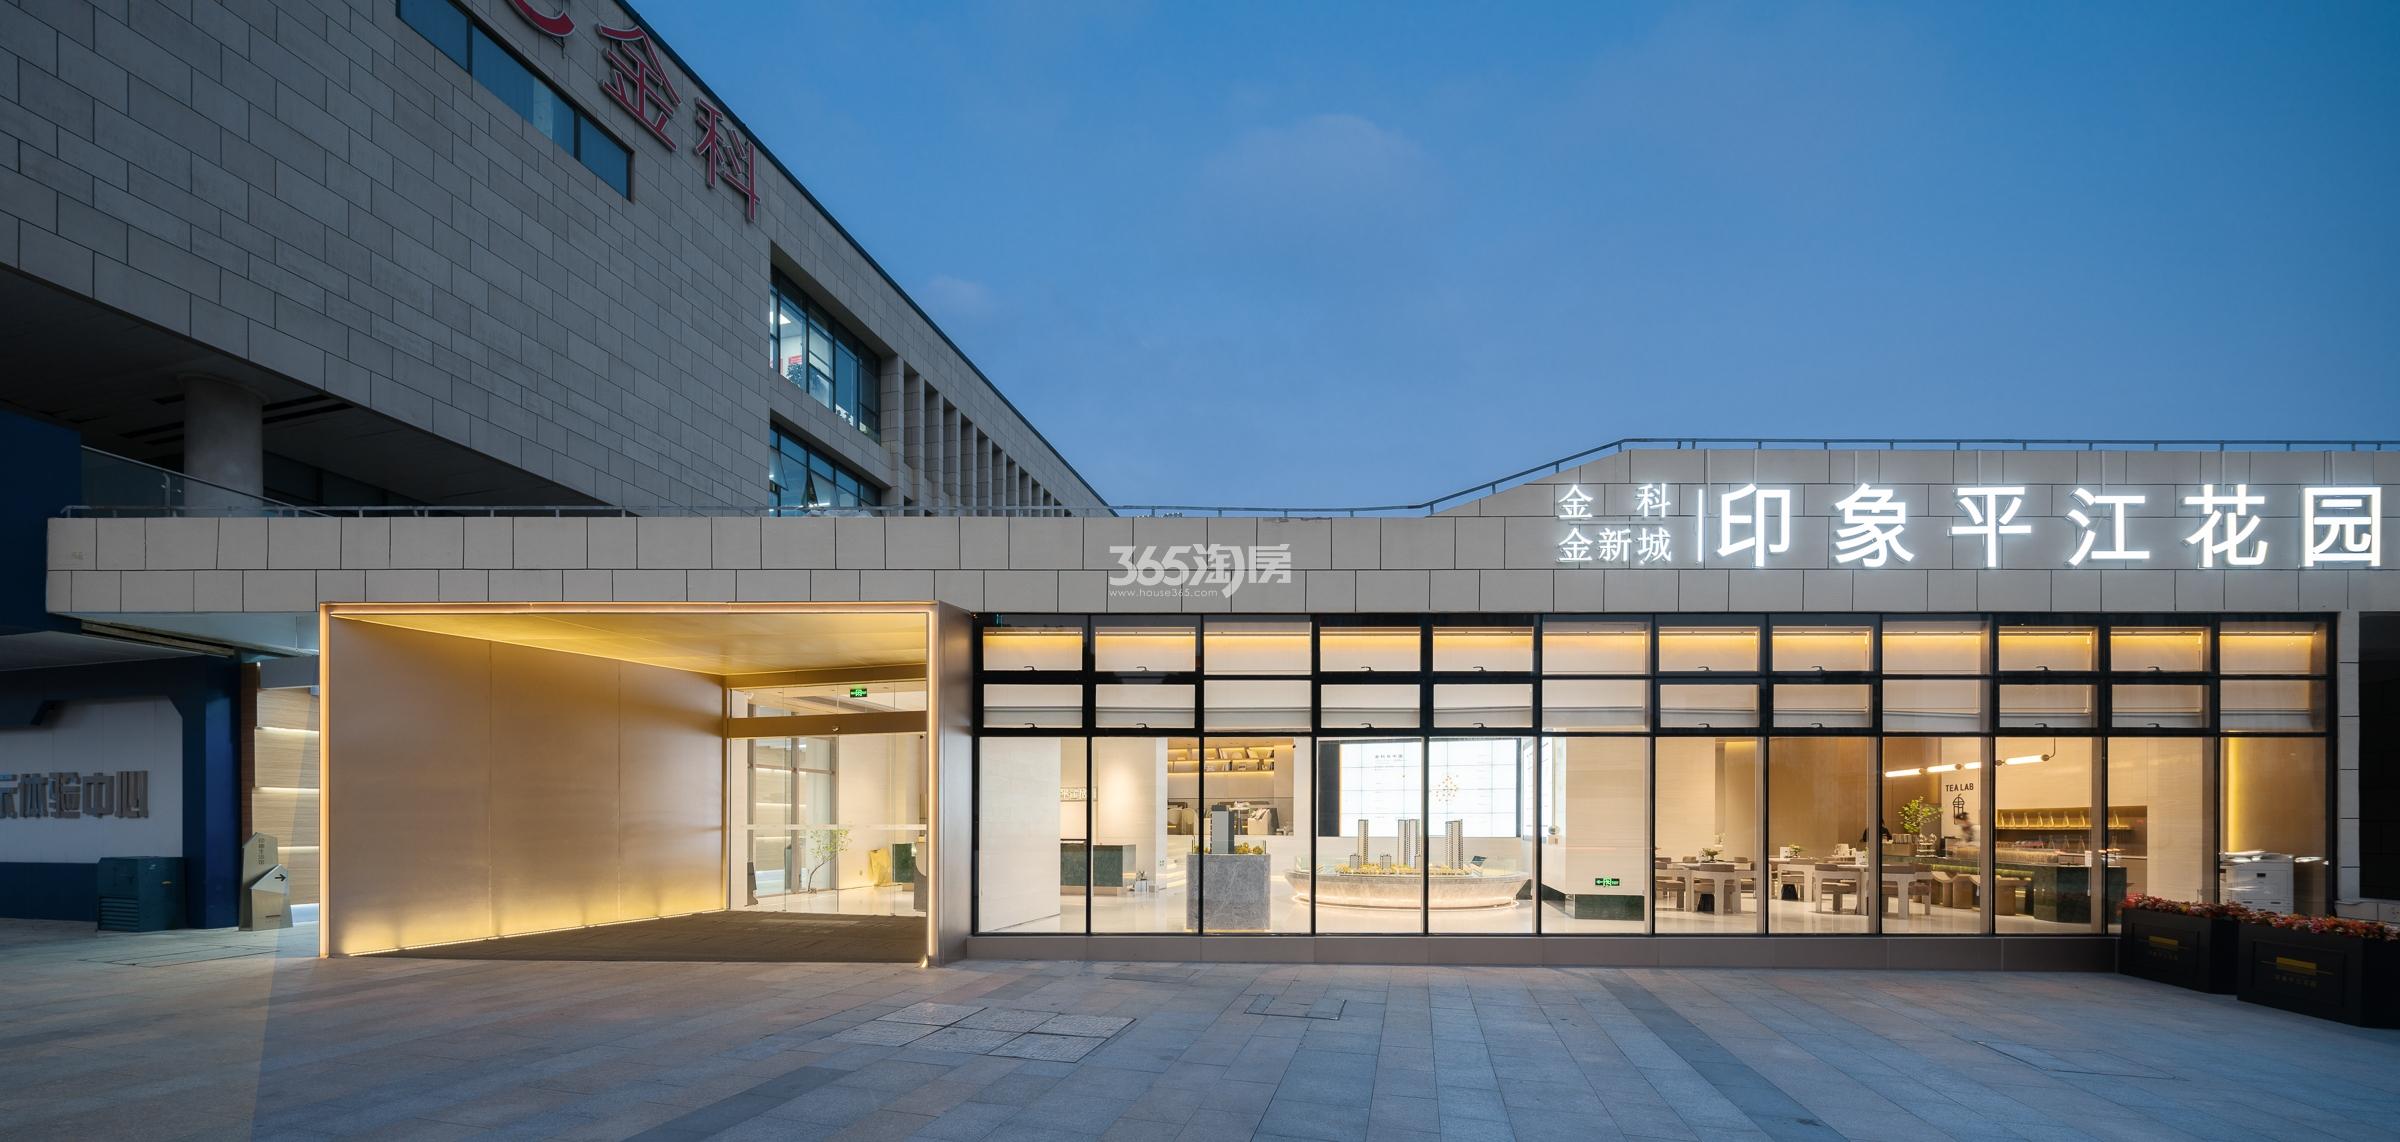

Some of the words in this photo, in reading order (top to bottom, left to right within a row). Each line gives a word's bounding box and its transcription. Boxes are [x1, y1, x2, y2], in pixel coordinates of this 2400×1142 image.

[596, 23, 762, 223] 金科
[1558, 483, 1672, 519] 金科
[1716, 483, 2382, 569] 印象平江花园
[1558, 527, 1673, 565] 金新城
[1945, 784, 1959, 792] TEA
[1959, 782, 1974, 791] LAB
